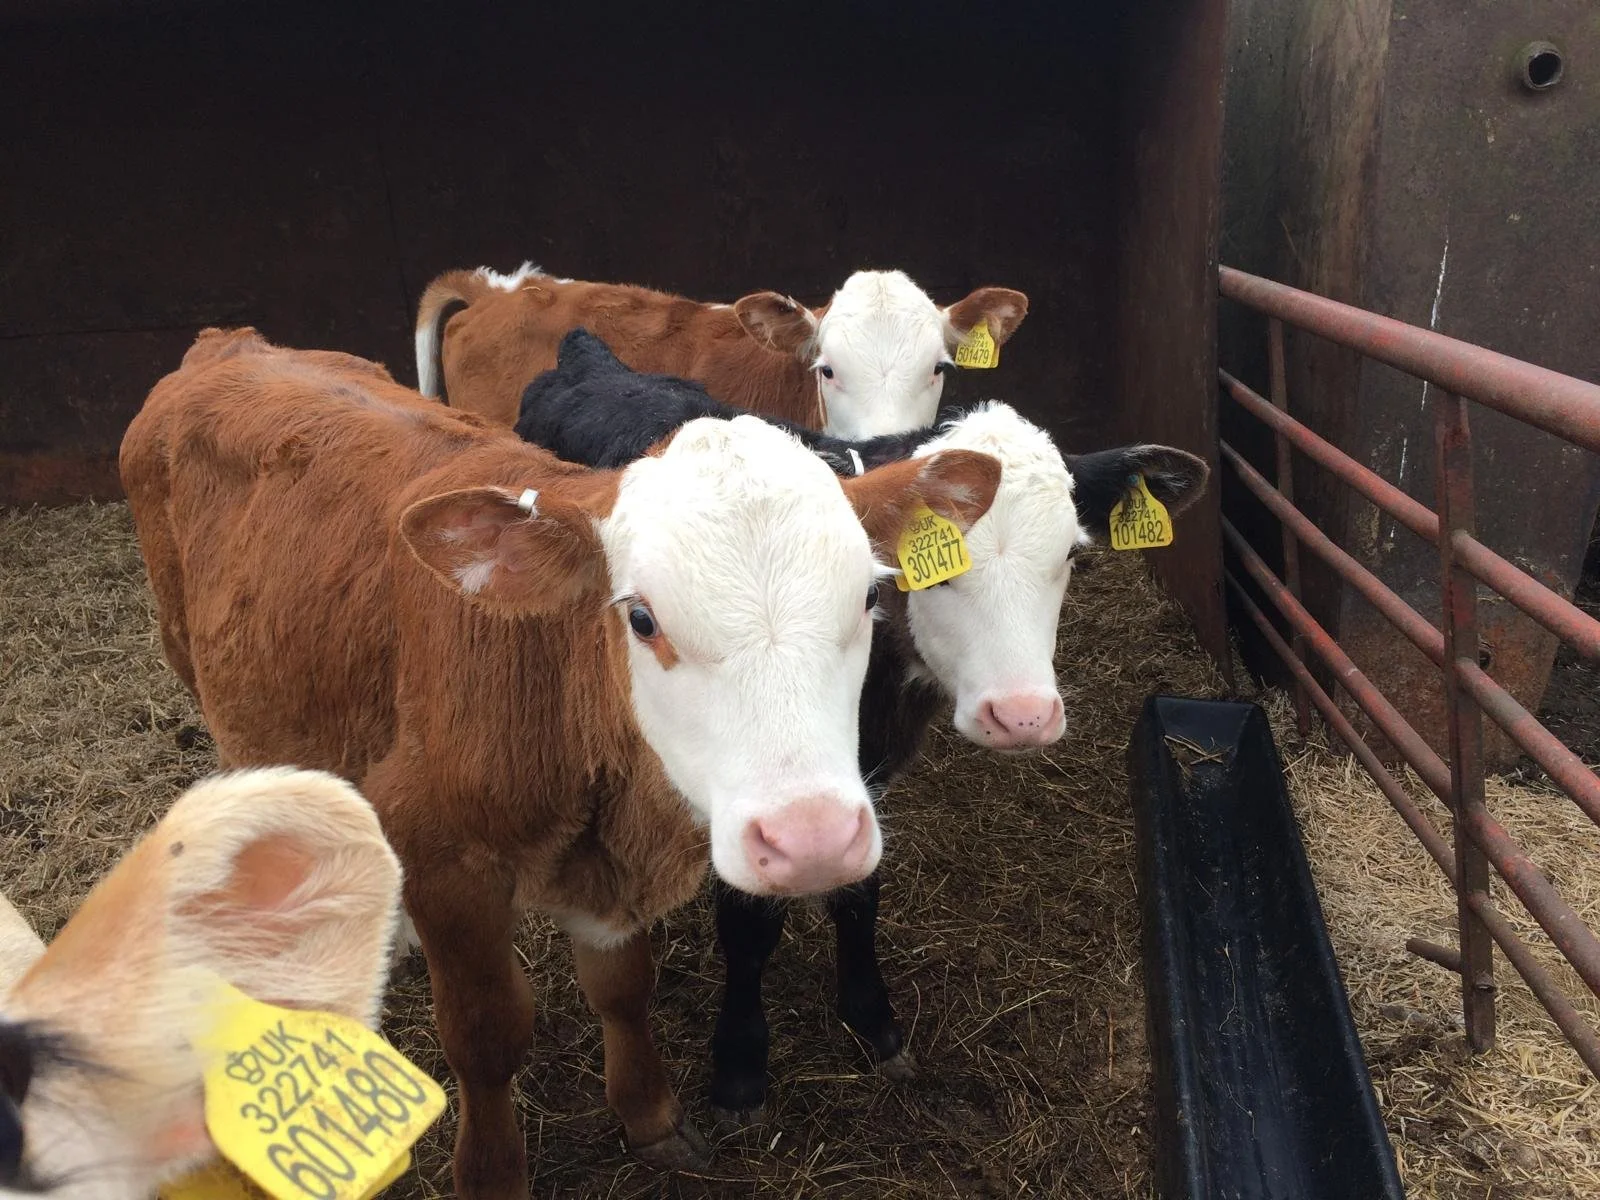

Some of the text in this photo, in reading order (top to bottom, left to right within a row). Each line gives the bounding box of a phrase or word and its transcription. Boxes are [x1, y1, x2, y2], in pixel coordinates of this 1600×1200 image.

[958, 347, 990, 364] 501479
[919, 515, 937, 531] UK
[1118, 509, 1157, 523] 322741
[909, 525, 955, 553] 322741
[1113, 520, 1164, 546] 101482
[907, 538, 963, 583] 301477
[250, 1020, 307, 1066] UK
[240, 1029, 356, 1134] 322741
[266, 1051, 427, 1200] 601480
